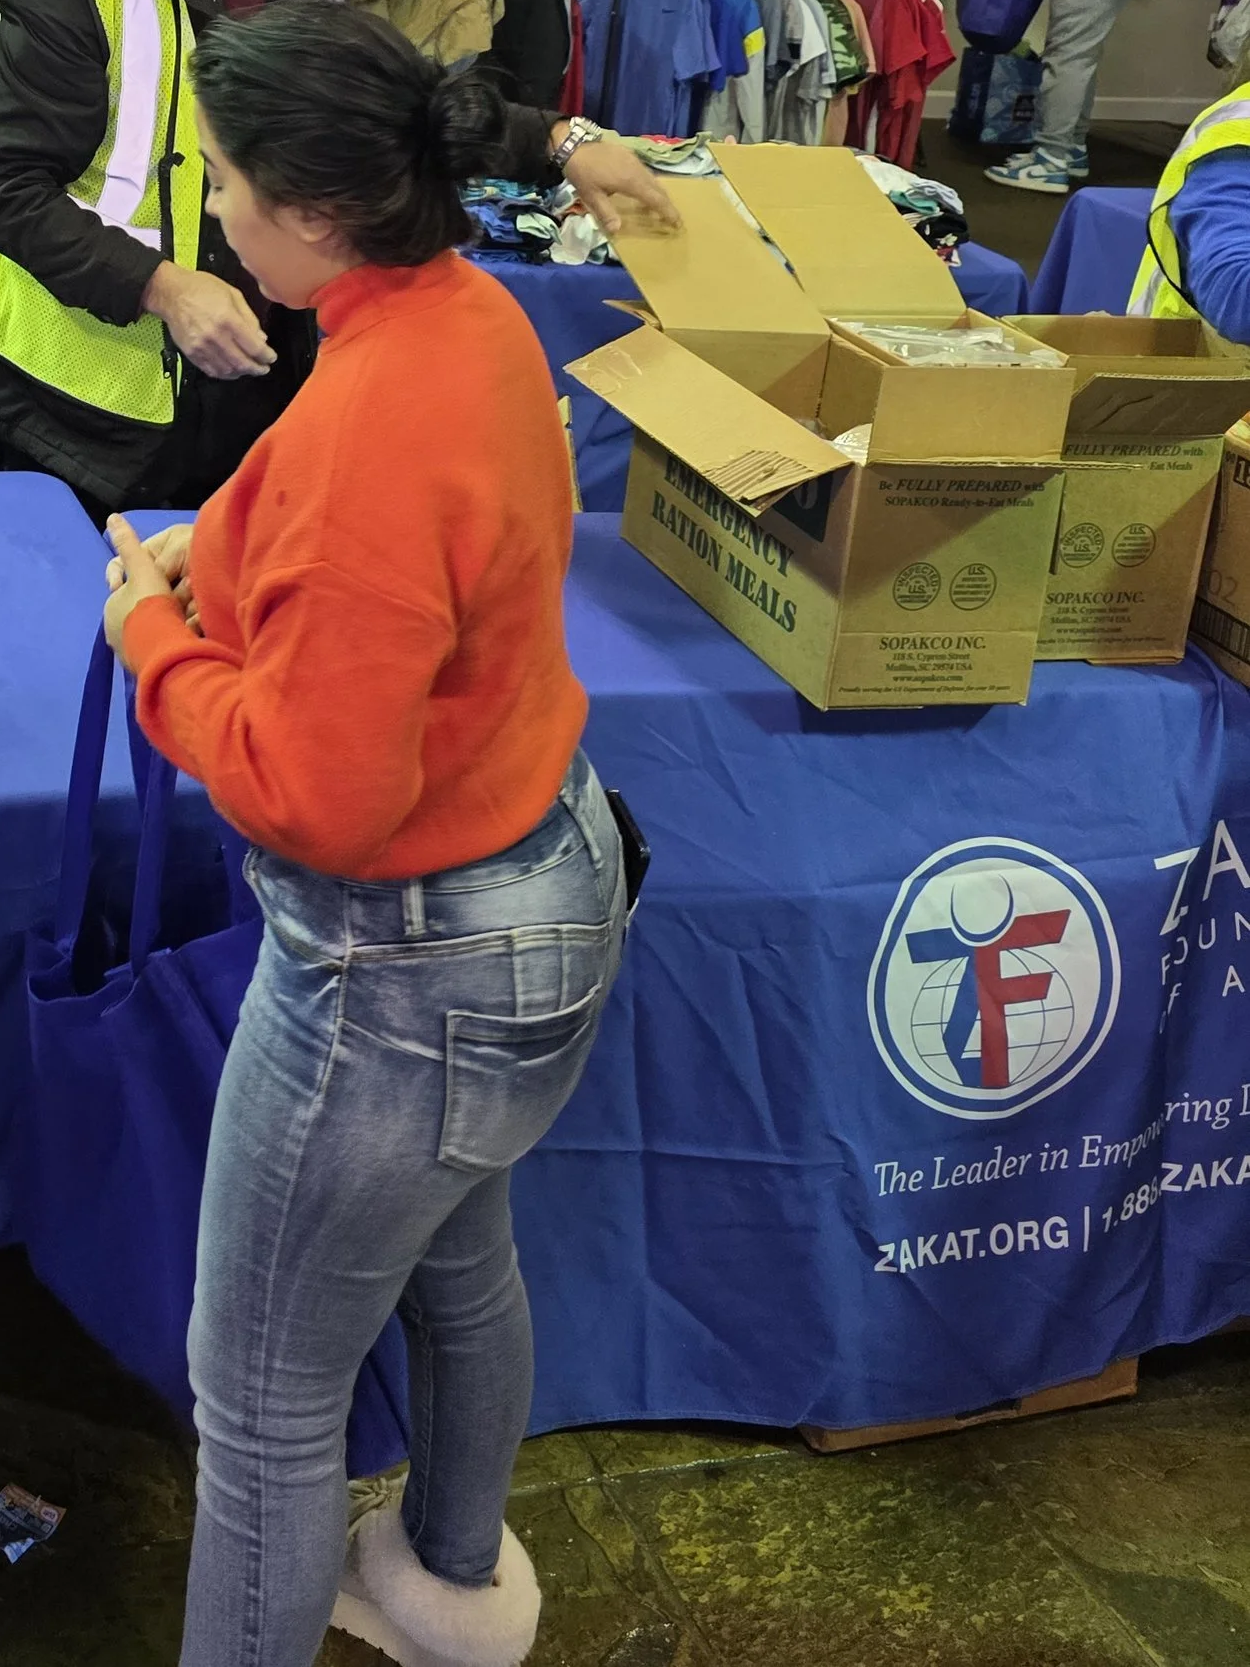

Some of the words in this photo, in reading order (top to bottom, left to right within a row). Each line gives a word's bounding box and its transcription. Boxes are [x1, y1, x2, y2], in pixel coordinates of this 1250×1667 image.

[1064, 444, 1108, 456] FULLY
[1111, 444, 1182, 457] PREPARED
[1183, 446, 1203, 456] with
[1167, 461, 1193, 471] Meals
[879, 480, 893, 491] Be
[896, 478, 944, 492] FULLY
[946, 479, 1022, 492] PREPARED
[885, 496, 939, 507] SOPAKCO
[1007, 498, 1035, 507] Meals
[664, 455, 795, 578] EMERGENCY
[652, 490, 724, 572] RATION
[724, 552, 798, 633] MEALS
[1045, 592, 1113, 605] SOPAKCO
[1116, 591, 1145, 603] INC.
[879, 636, 953, 650] SOPAKCO
[956, 636, 986, 650] INC.
[874, 1161, 923, 1196] The
[933, 1146, 1032, 1190] Leader
[1039, 1143, 1069, 1173] in
[874, 1215, 1069, 1274] ZAKAT.ORG
